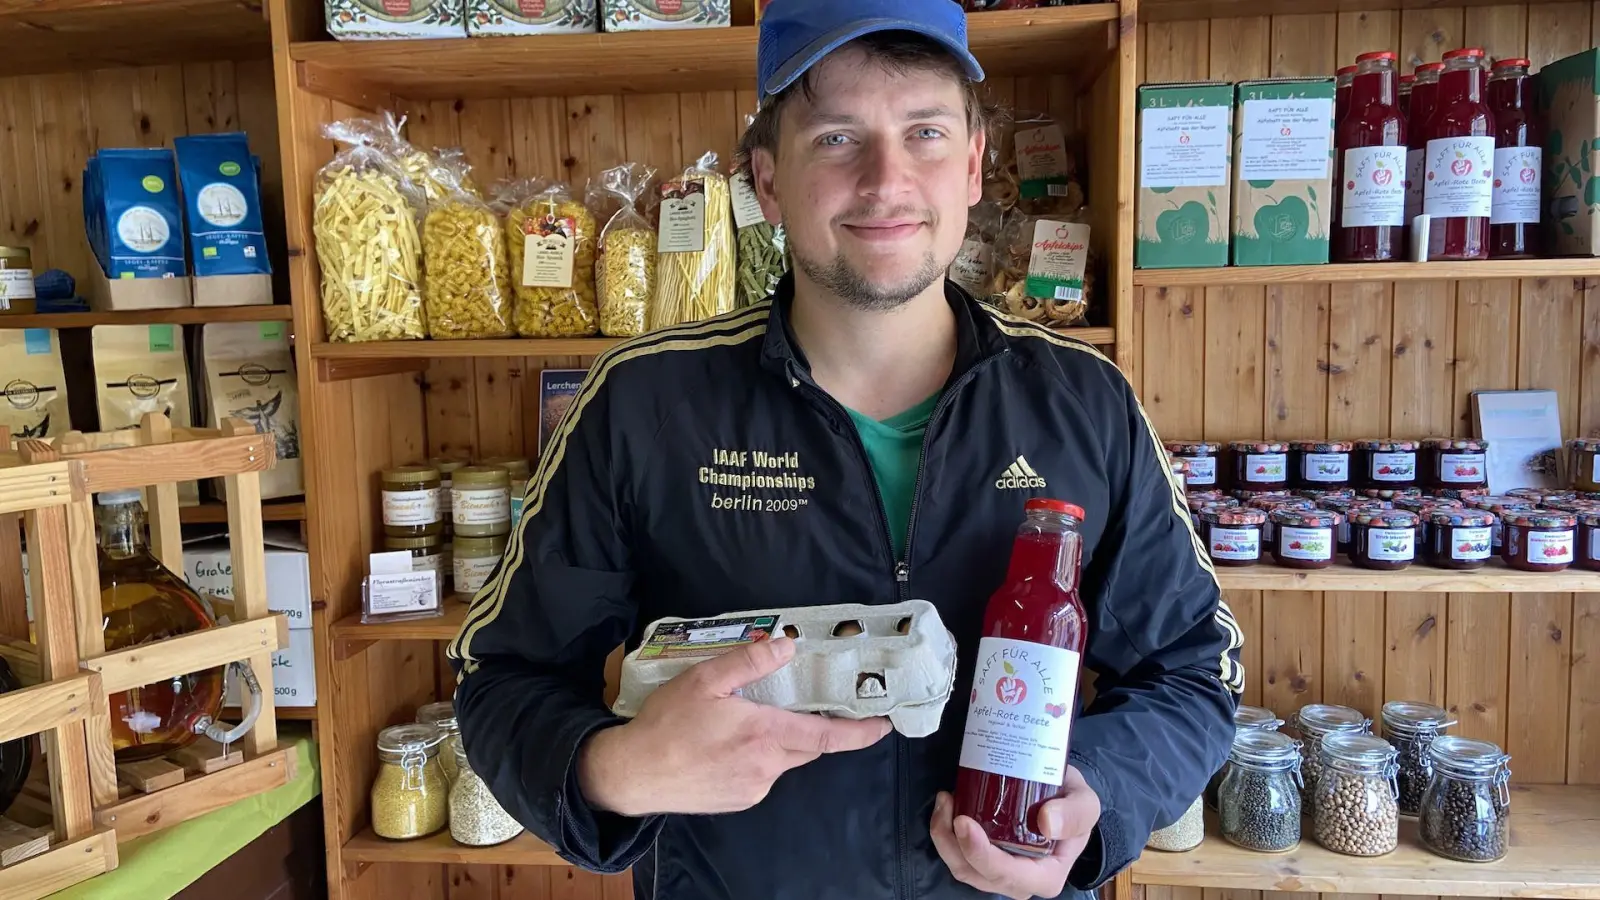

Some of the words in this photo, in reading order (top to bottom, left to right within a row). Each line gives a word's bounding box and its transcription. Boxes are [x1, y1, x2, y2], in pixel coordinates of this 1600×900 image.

[1149, 97, 1156, 107] 3
[1160, 97, 1166, 107] L
[1355, 156, 1371, 178] SAFT
[1374, 151, 1392, 160] FÜR
[1435, 147, 1449, 169] SAFT
[1452, 141, 1472, 150] FÜR
[1502, 155, 1518, 177] SAFT
[1035, 239, 1085, 253] Apfelchips
[712, 448, 748, 468] IAAF
[752, 450, 799, 468] World
[698, 466, 816, 492] Championships
[995, 475, 1047, 489] adidas
[711, 492, 763, 511] berlin
[978, 652, 998, 686] SAFT
[1002, 645, 1029, 662] FÜR
[1030, 660, 1054, 695] ALLE
[973, 705, 1020, 722] Apfel-Rote
[1023, 714, 1050, 727] Beete
